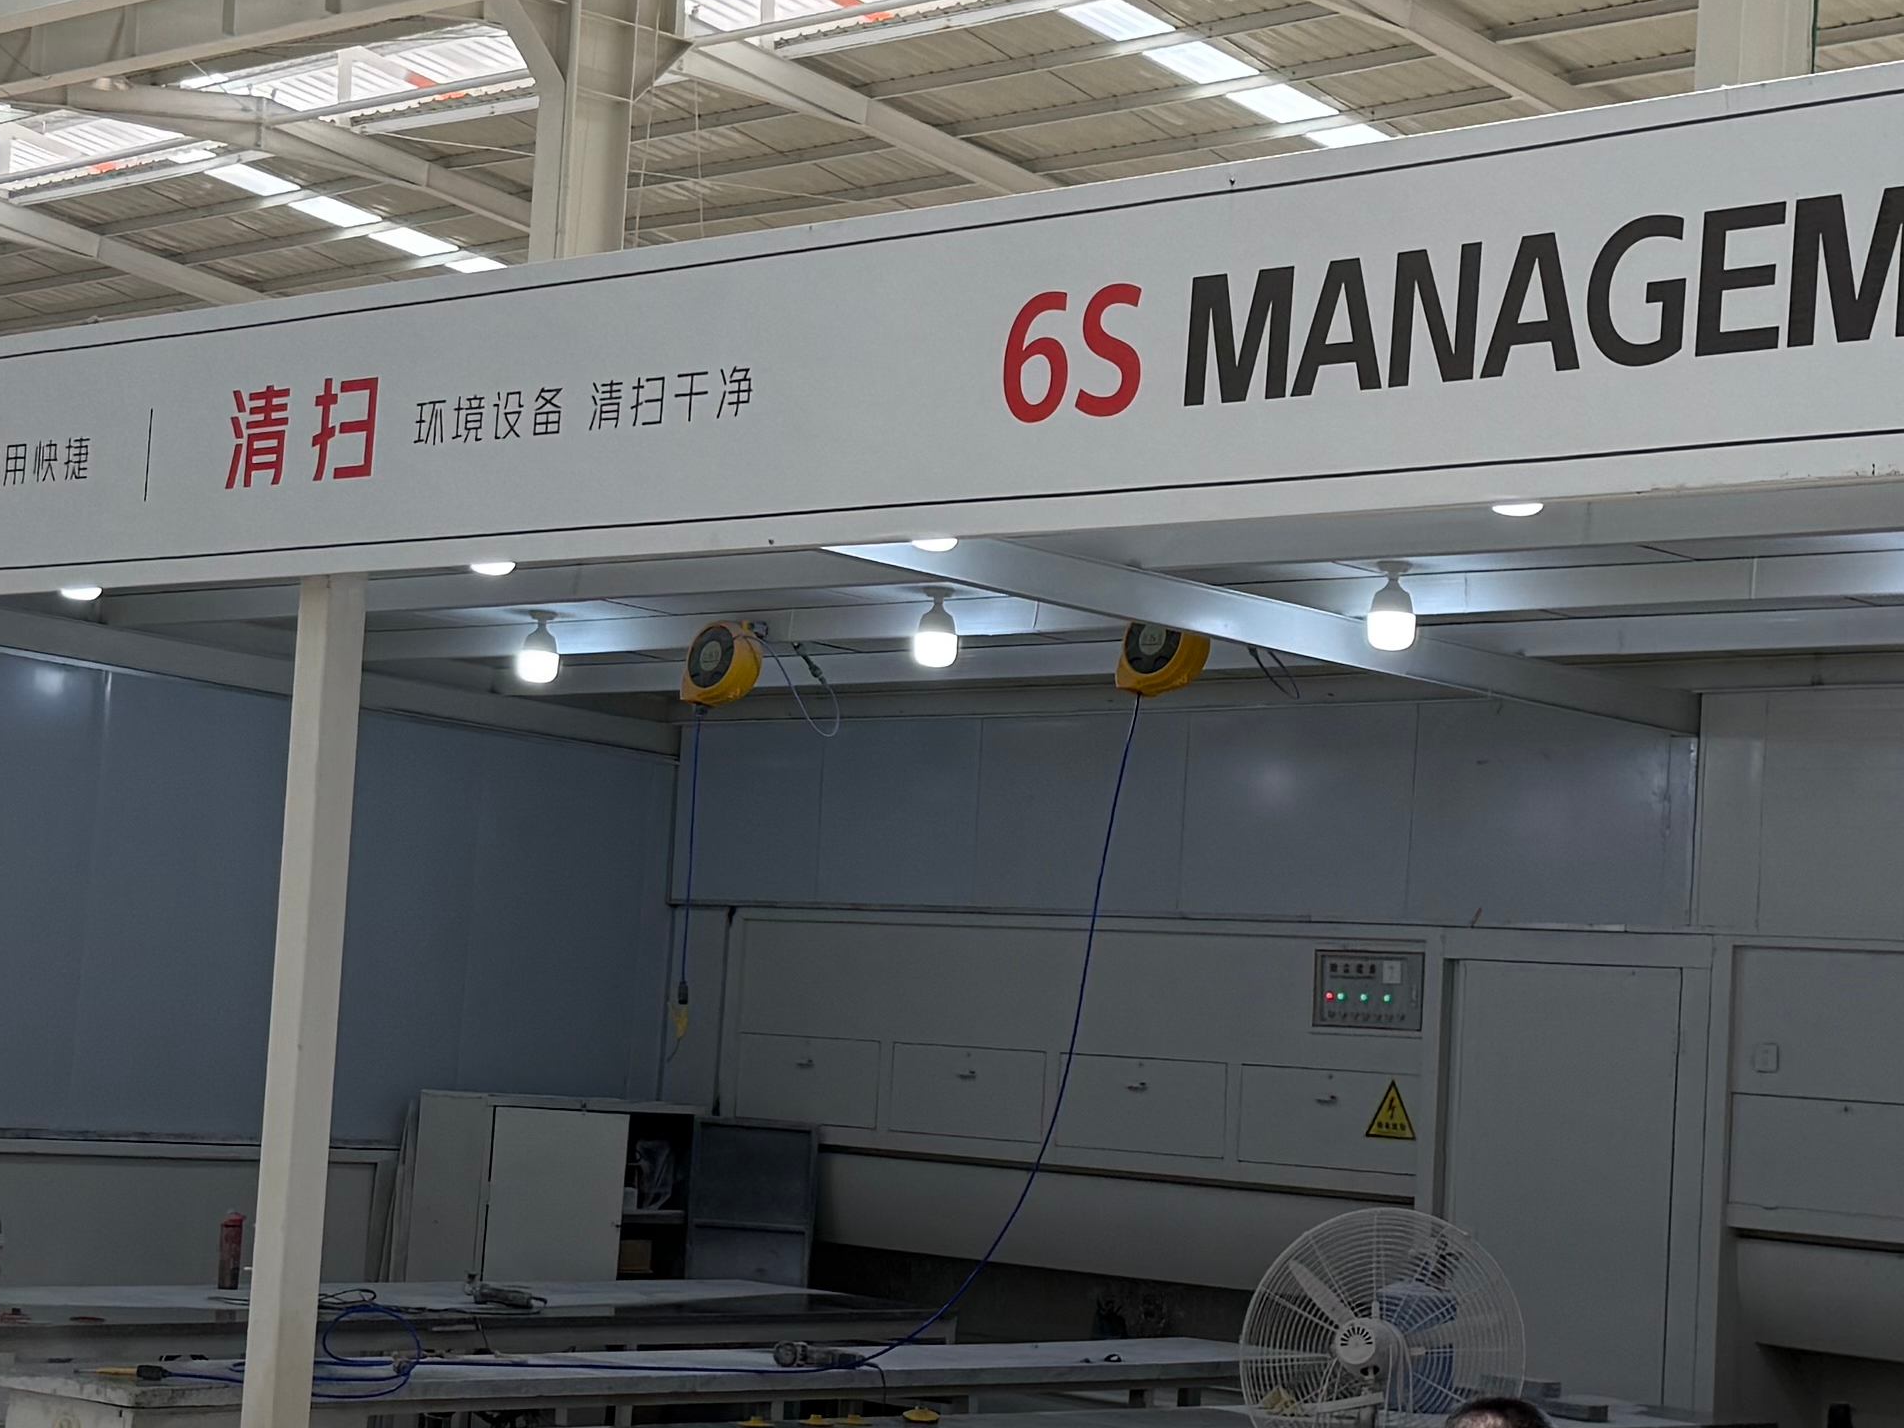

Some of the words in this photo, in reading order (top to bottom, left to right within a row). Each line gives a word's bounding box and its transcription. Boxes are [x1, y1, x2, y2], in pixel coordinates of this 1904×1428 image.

[1001, 283, 1143, 424] 6S
[224, 377, 380, 491] 清扫
[413, 387, 564, 446] 环境设备
[588, 366, 754, 431] 清扫干净
